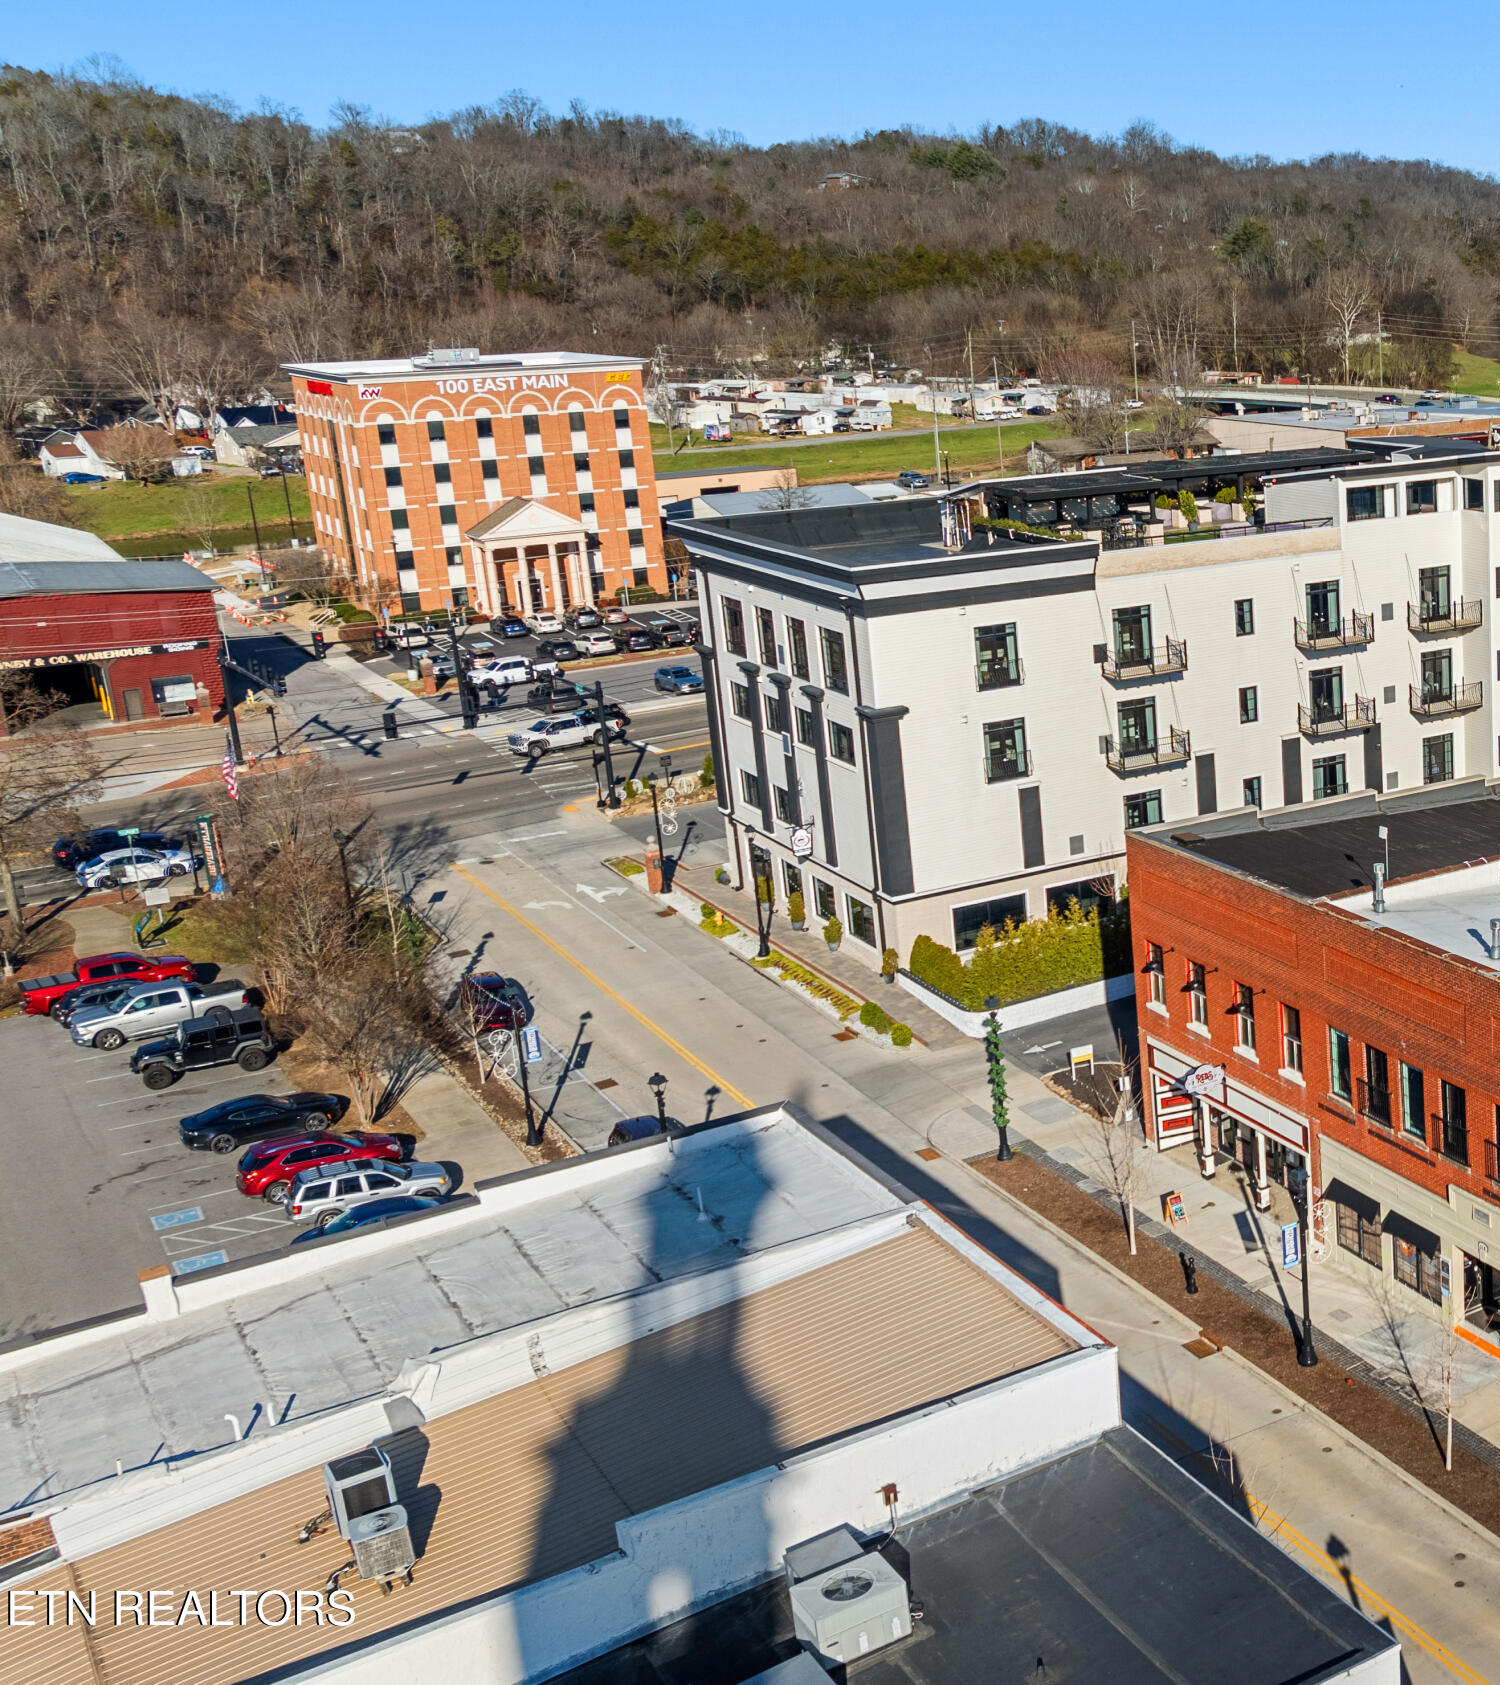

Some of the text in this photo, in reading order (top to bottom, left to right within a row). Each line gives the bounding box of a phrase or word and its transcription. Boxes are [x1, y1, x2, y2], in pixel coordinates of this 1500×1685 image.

[436, 374, 569, 394] 100 EAST MAIN
[0, 646, 153, 670] NBY & CO. WAREHOUSE
